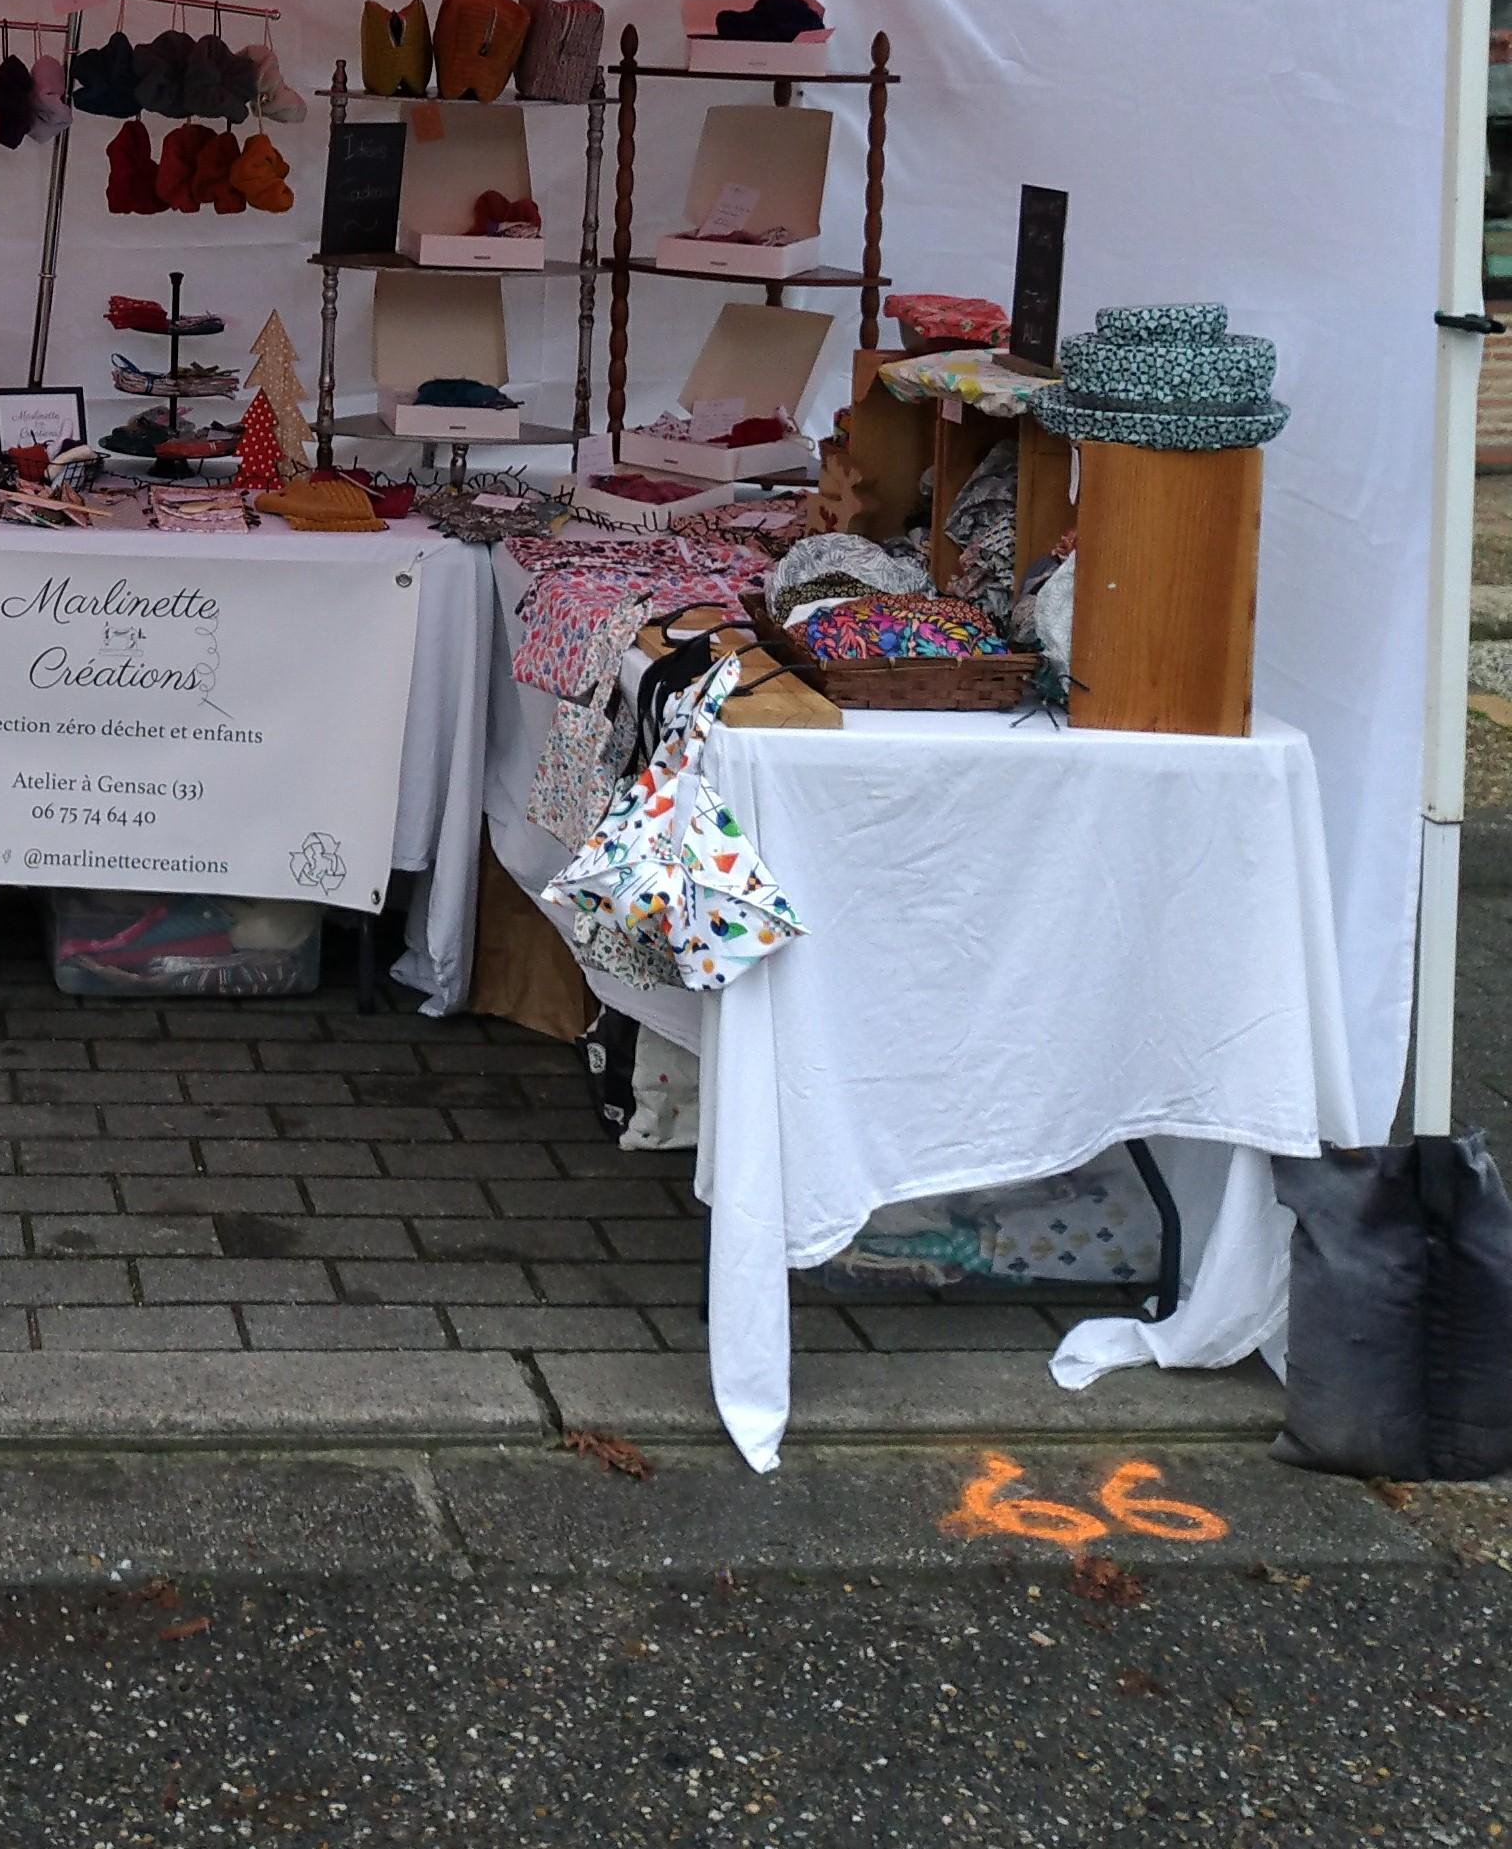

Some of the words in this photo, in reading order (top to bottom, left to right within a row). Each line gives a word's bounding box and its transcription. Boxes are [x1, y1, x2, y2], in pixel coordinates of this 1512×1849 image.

[0, 576, 220, 624] Marlinette
[29, 646, 201, 690] Créations
[56, 718, 96, 736] zéro
[101, 719, 164, 739] déchet
[170, 725, 187, 739] et
[192, 723, 263, 744] enfants
[12, 772, 76, 791] Atelier
[81, 775, 92, 792] à
[97, 775, 167, 796] Gensac
[172, 779, 204, 801] (33)
[31, 804, 54, 819] 06
[59, 806, 78, 824] 75
[83, 807, 101, 825] 74
[106, 807, 127, 826] 64
[132, 810, 156, 826] 40
[24, 848, 229, 874] @marlinettecreations
[958, 1451, 1230, 1544] 66
